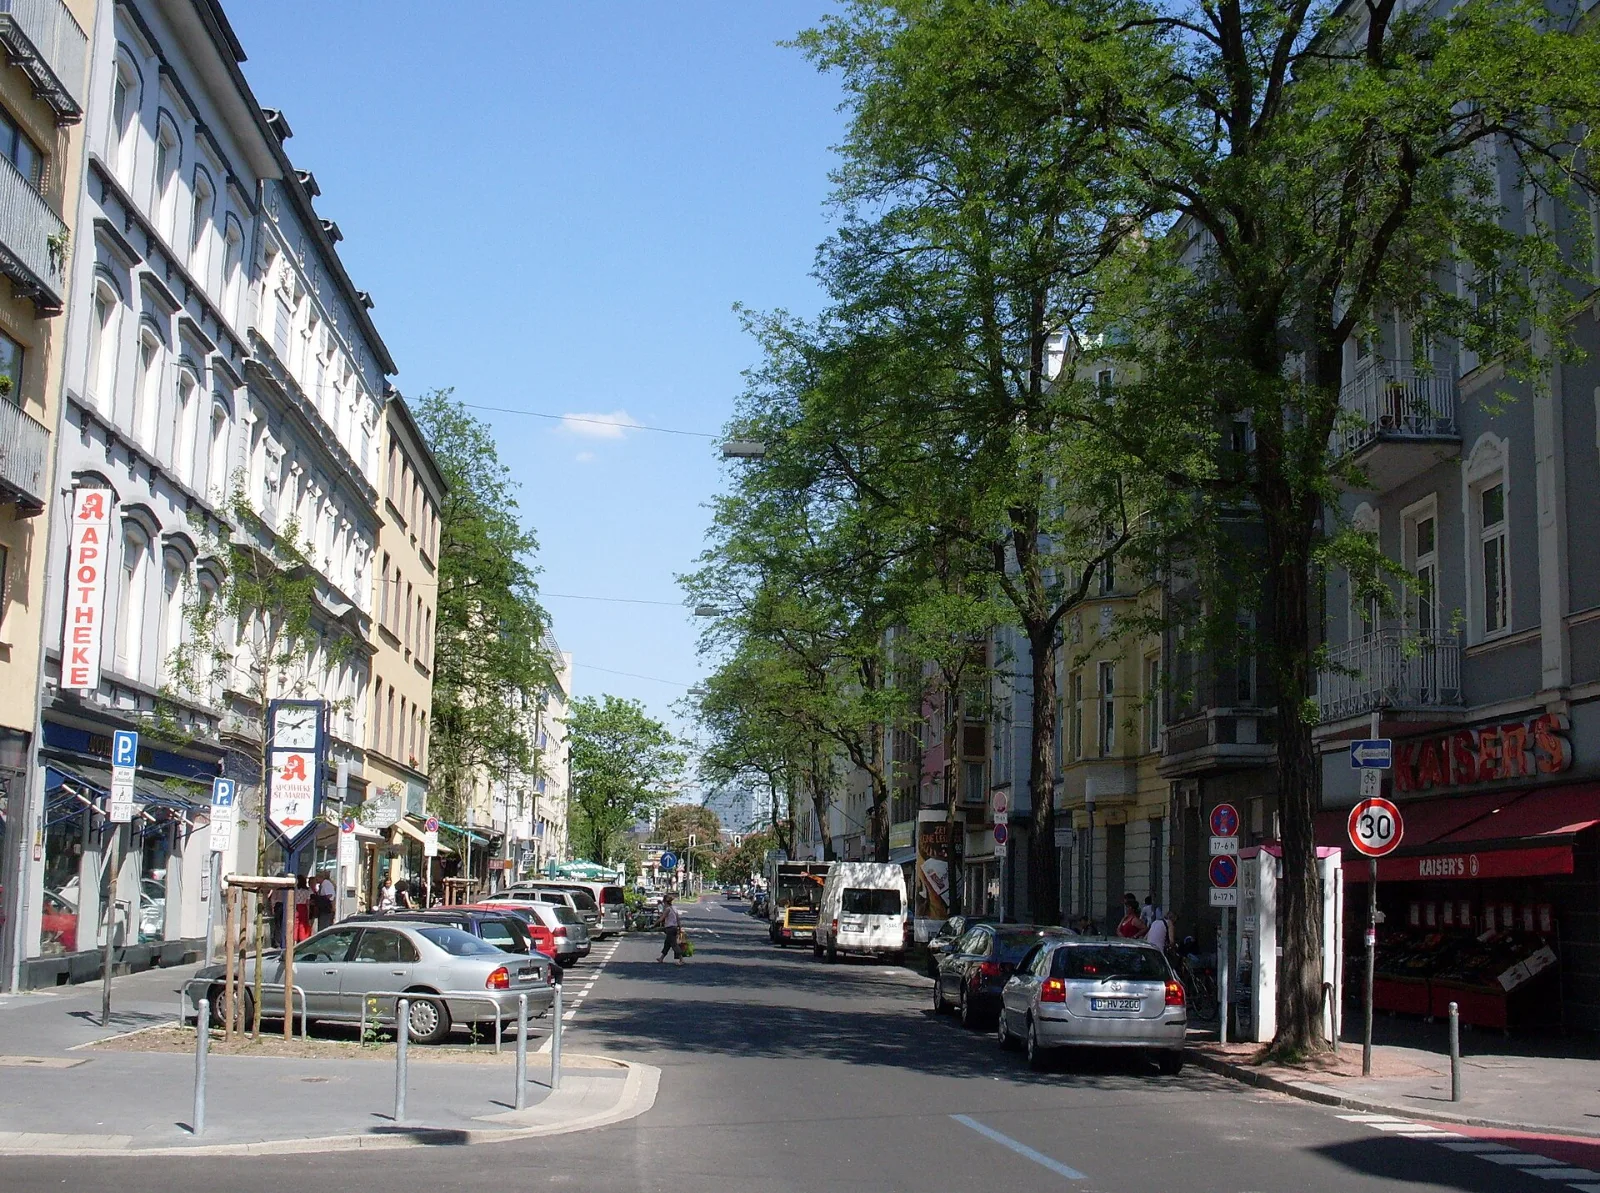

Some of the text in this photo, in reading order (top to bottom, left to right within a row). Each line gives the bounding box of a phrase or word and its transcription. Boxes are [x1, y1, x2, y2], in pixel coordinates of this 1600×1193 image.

[70, 527, 99, 685] APOTHEKE
[118, 735, 132, 763] P
[1395, 713, 1570, 791] KAISER'S
[216, 782, 230, 805] P
[274, 783, 311, 792] APOTHEKE
[284, 791, 311, 799] MARTIN
[1361, 814, 1391, 840] 30
[1213, 842, 1235, 850] 17-6 h
[1419, 857, 1465, 876] KAISER'S
[1213, 893, 1234, 901] 6-17 h
[1097, 1000, 1103, 1008] D
[1108, 1000, 1118, 1008] HV
